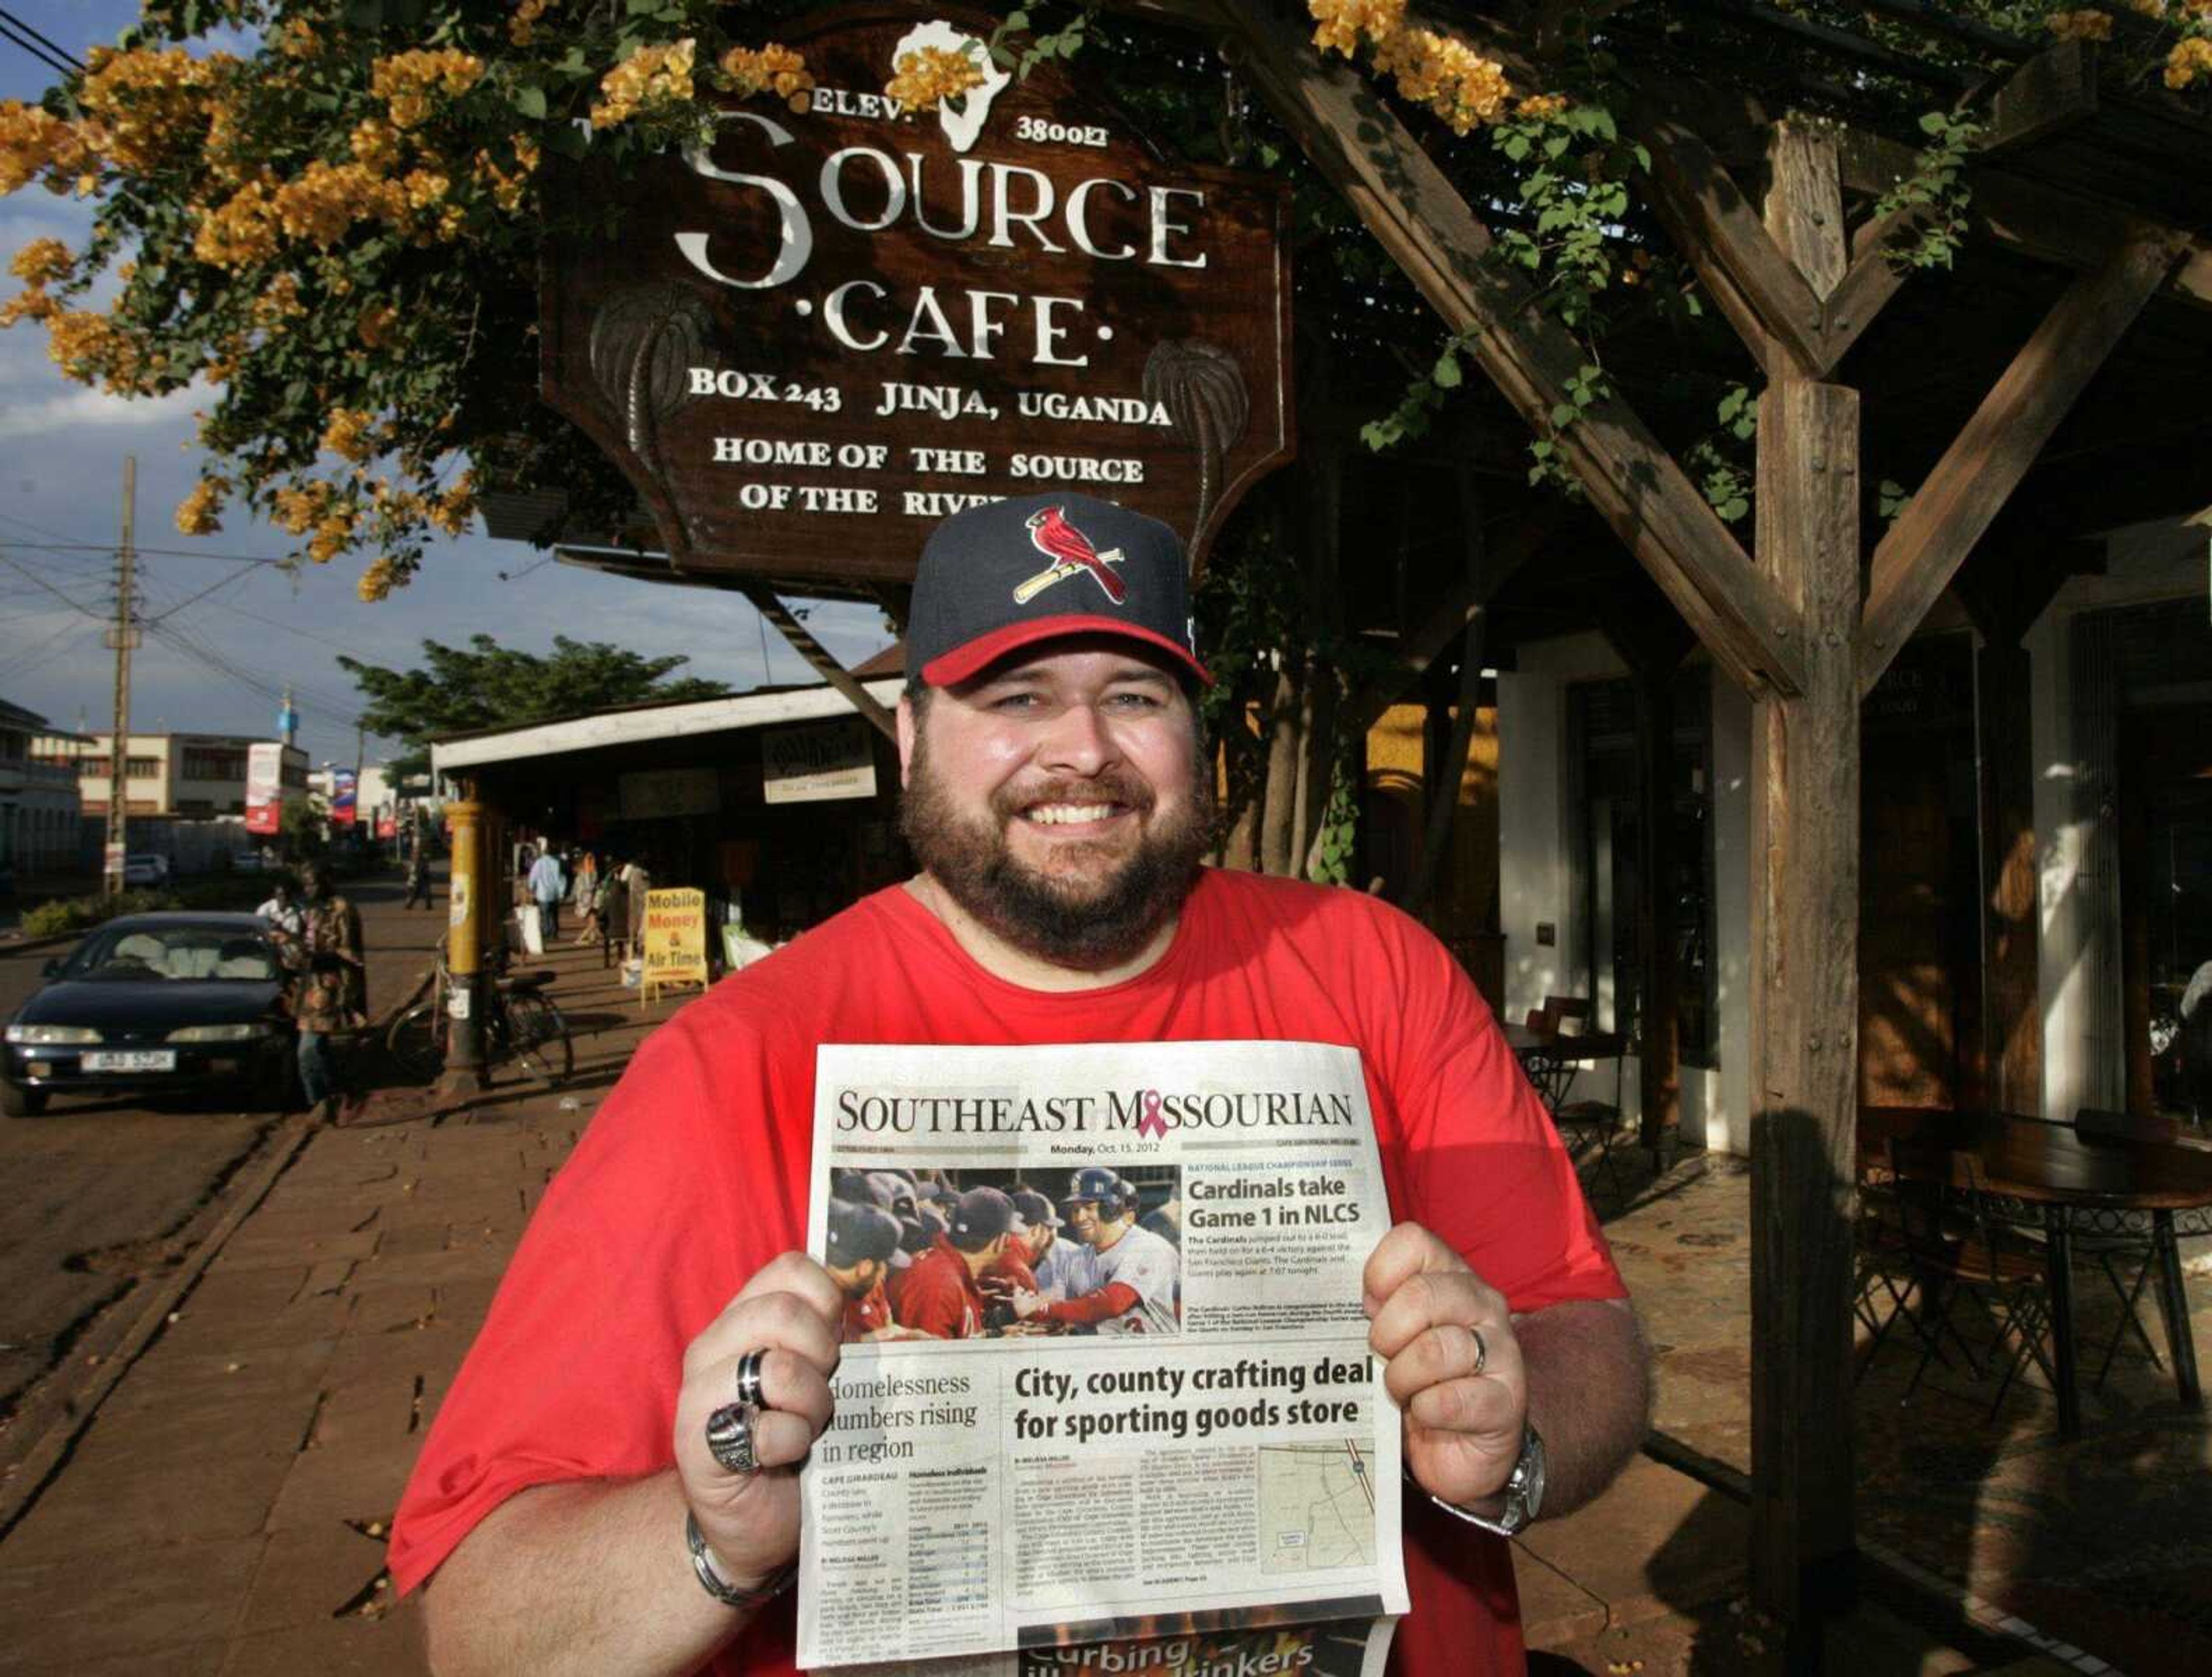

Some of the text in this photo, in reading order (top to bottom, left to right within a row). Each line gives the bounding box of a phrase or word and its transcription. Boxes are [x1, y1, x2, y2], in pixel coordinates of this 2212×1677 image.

[813, 88, 913, 122] ELEV.
[674, 111, 1207, 289] SOURCE
[823, 279, 1089, 366] CAFE
[688, 368, 1173, 426] BOX 243 JINJA, UGANDA
[713, 437, 1145, 483] HOME OF THE SOURCE
[740, 484, 1007, 516] OF THE RIVE
[649, 893, 700, 908] Mobile
[649, 914, 698, 929] Money
[649, 951, 701, 967] Air Time
[836, 1090, 1353, 1133] SOUTHEAST MSSOURIAN
[1051, 1144, 1095, 1156] Monday,
[1135, 1142, 1161, 1152] 2012
[1188, 1176, 1346, 1200] Cardinals take
[1188, 1202, 1361, 1228] Game 1 in NLCS
[1188, 1236, 1204, 1244] The
[1206, 1235, 1247, 1244] Cardinals
[1015, 1355, 1374, 1403] City, county crafting deal
[920, 1401, 978, 1428] rising
[1014, 1398, 1359, 1443] for sporting goods store
[823, 1435, 914, 1464] in region
[1174, 1644, 1314, 1677] inkers
